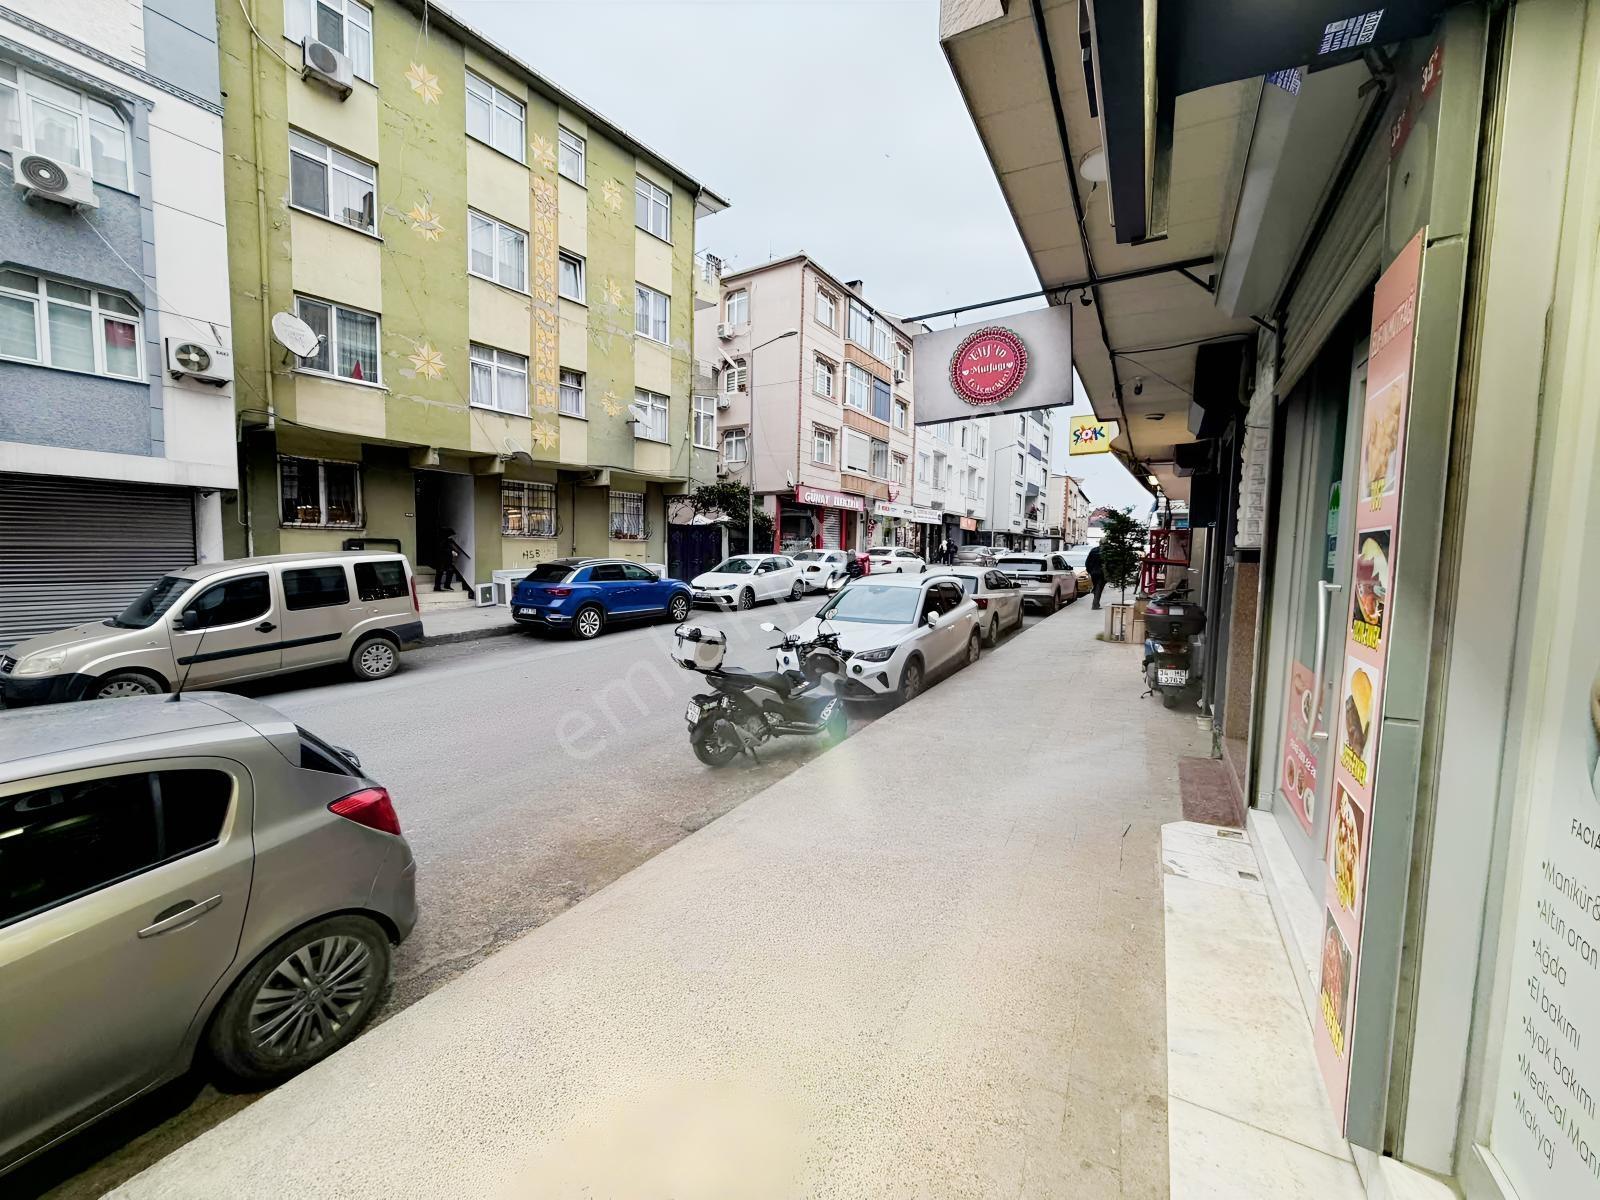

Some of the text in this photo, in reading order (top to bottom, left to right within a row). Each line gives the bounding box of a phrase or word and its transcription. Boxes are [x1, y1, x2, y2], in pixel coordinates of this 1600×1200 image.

[1534, 938, 1567, 987] Ağda
[1567, 928, 1598, 970] oran
[1529, 976, 1581, 1052] El bakımı
[1520, 1053, 1567, 1131] Medical
[1525, 1016, 1596, 1120] Ayak bakımı
[1515, 1090, 1557, 1170] Makyaj
